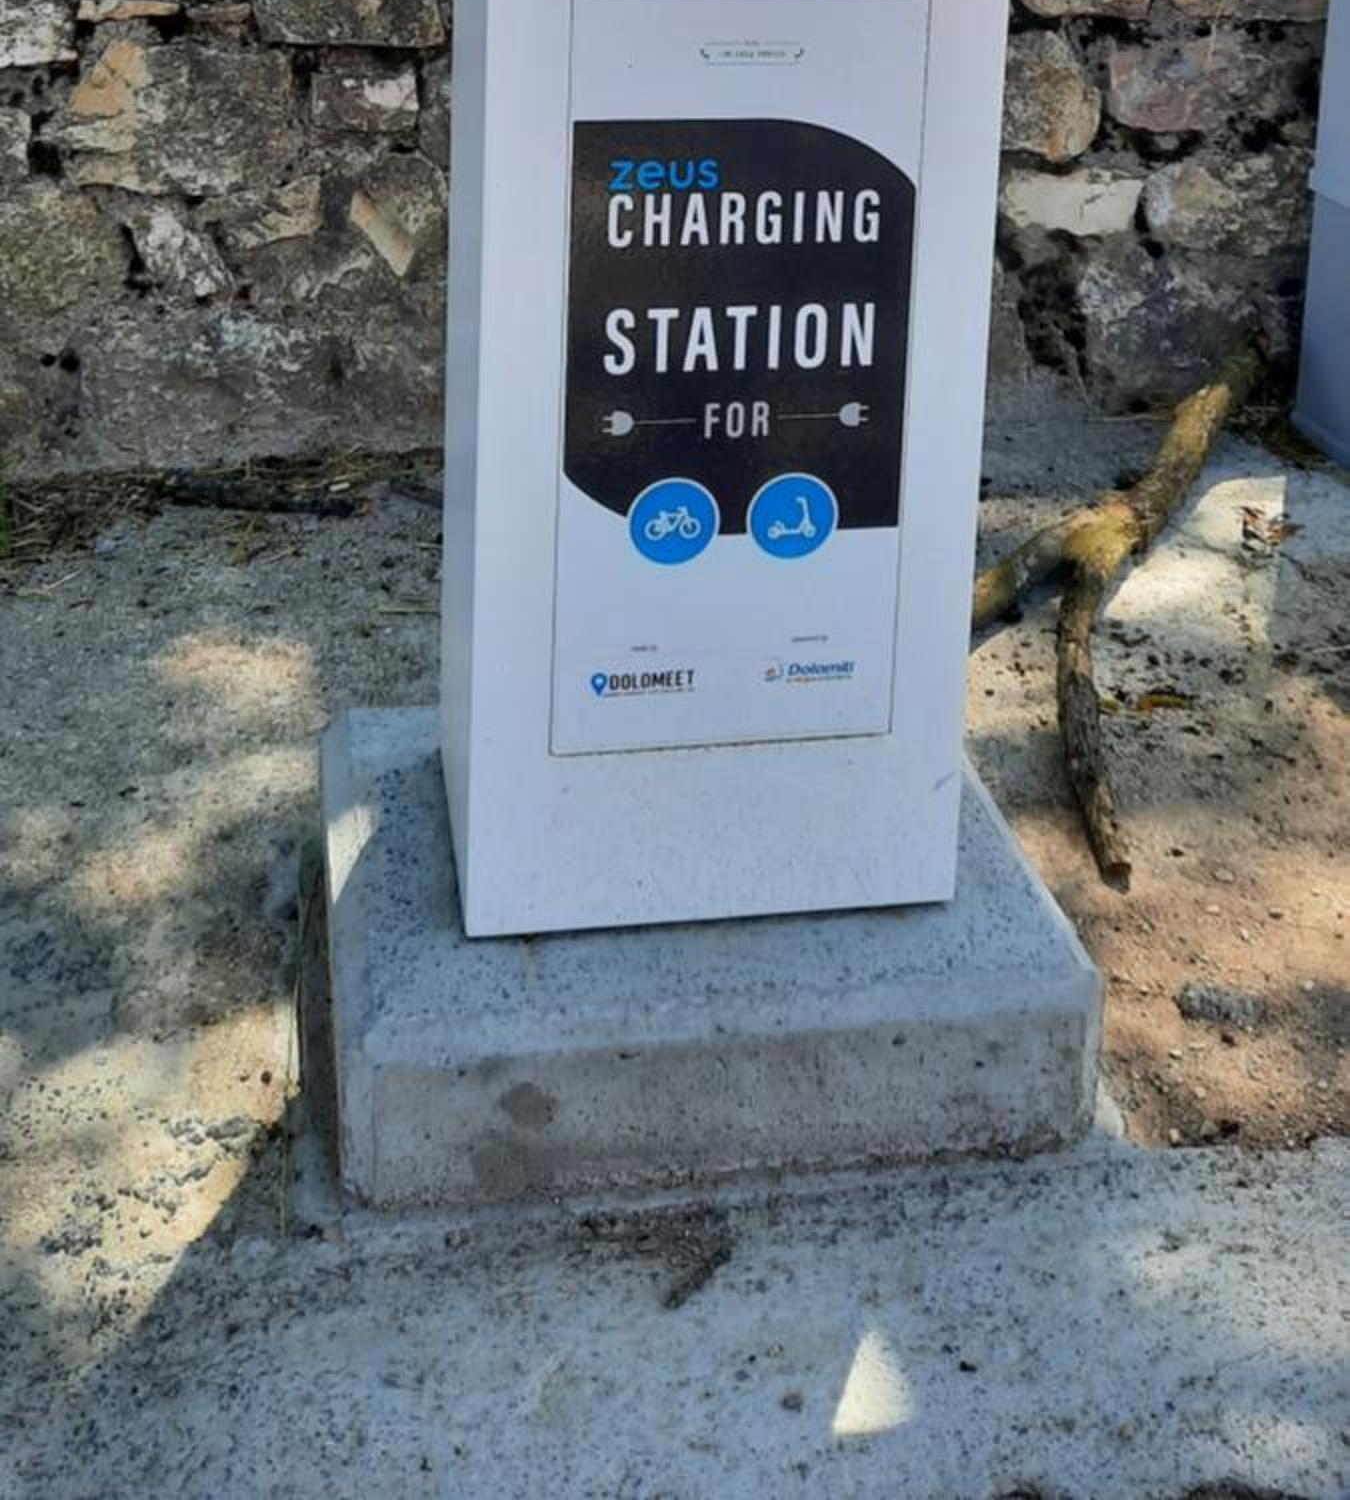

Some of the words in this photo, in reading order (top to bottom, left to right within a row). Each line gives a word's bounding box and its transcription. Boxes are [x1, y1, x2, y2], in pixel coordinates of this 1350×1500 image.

[608, 157, 720, 191] zeus
[607, 189, 881, 249] CHARGING
[603, 303, 876, 375] STATION
[704, 401, 770, 439] FOR
[609, 669, 695, 691] DOLOMEET
